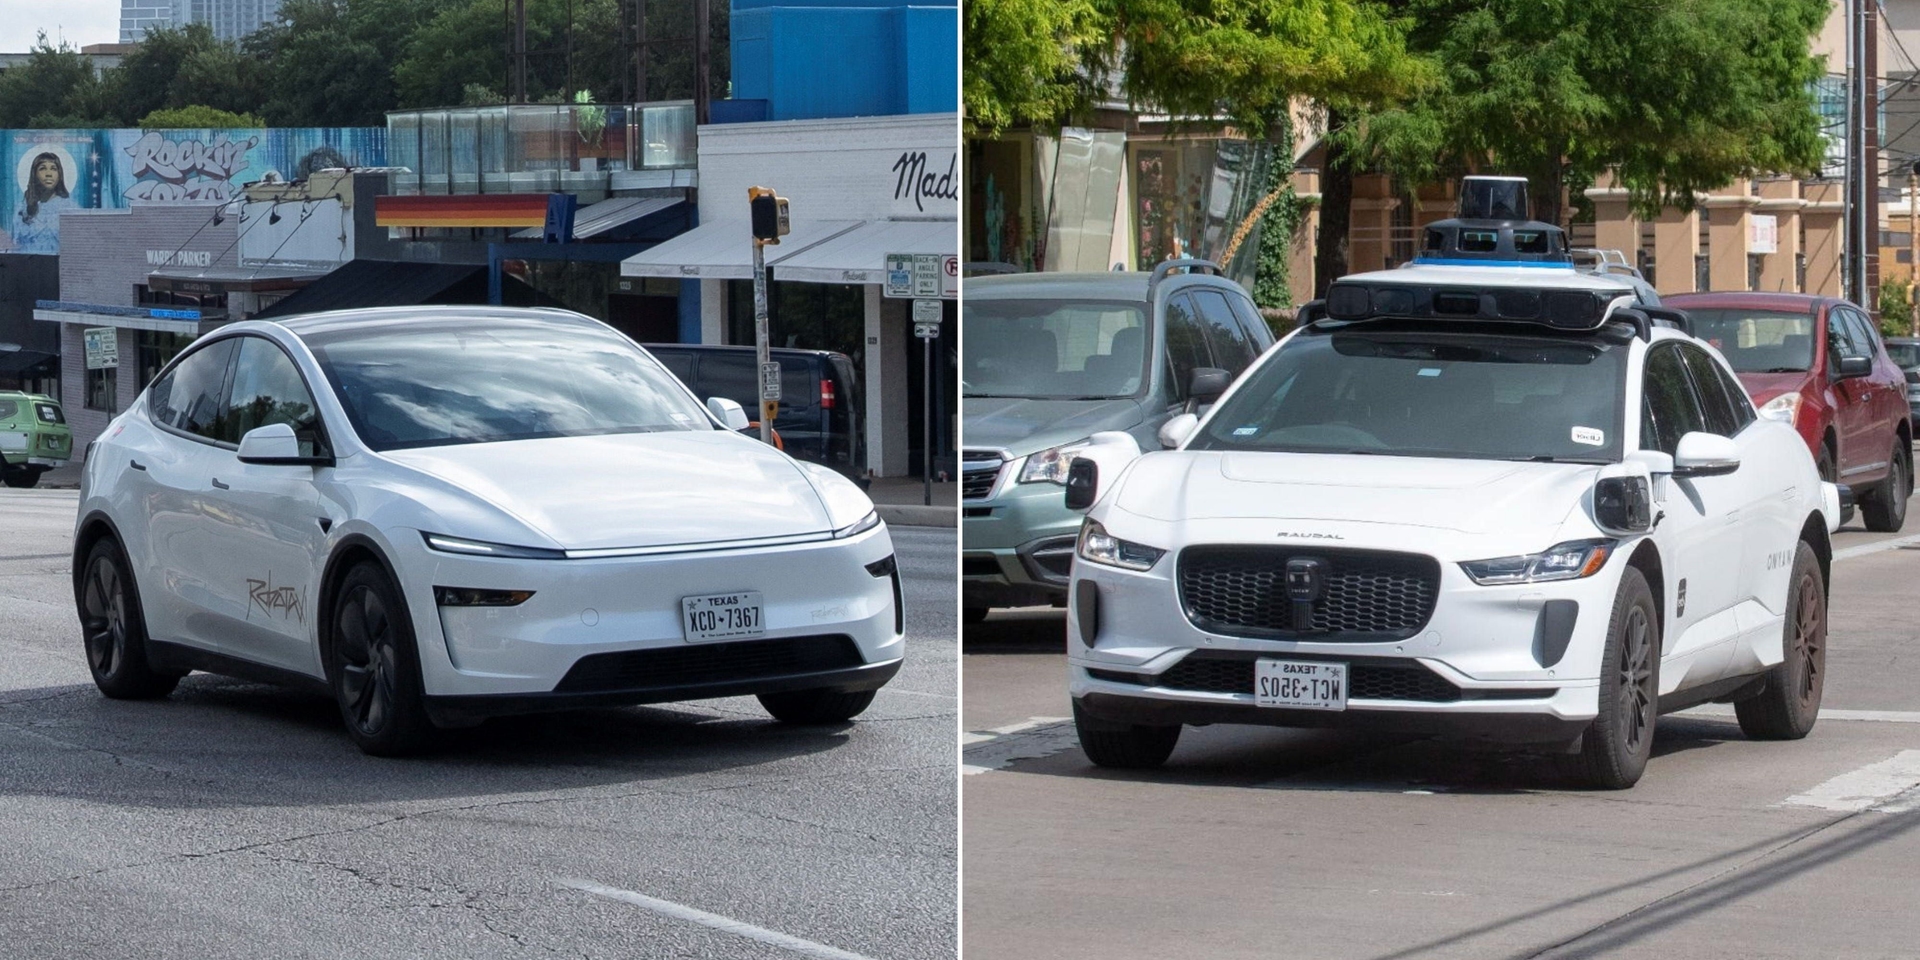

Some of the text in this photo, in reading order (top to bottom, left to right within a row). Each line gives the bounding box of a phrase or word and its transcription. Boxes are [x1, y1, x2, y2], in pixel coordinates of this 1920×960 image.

[146, 250, 211, 267] WARBY PARKER
[918, 264, 935, 272] ANGLE
[708, 596, 739, 606] TEXAS
[689, 607, 759, 632] XCD 7367
